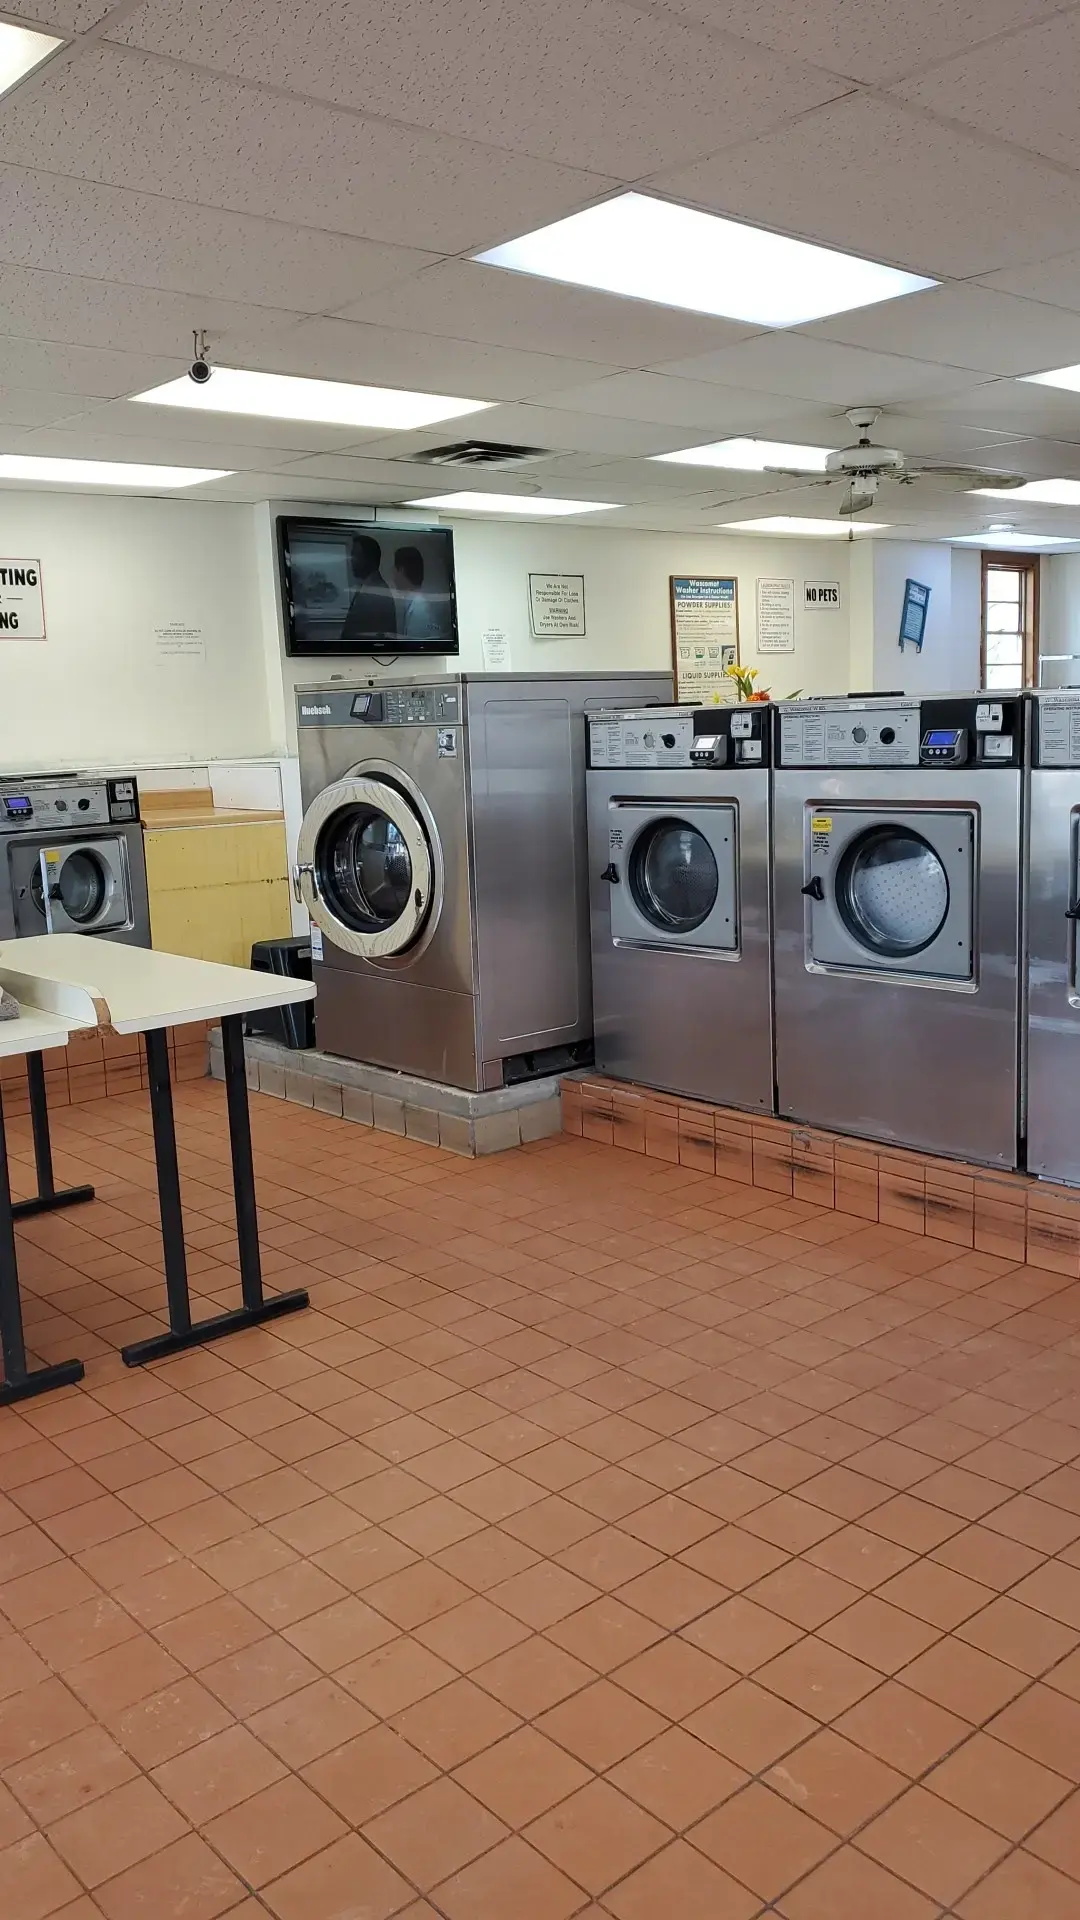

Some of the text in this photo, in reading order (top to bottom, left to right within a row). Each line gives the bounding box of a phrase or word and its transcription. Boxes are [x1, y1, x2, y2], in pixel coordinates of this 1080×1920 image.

[0, 568, 37, 586] TING
[676, 586, 699, 594] Washer
[806, 588, 838, 602] NO PETS
[677, 601, 703, 609] POWDER
[302, 705, 331, 715] Huebsch
